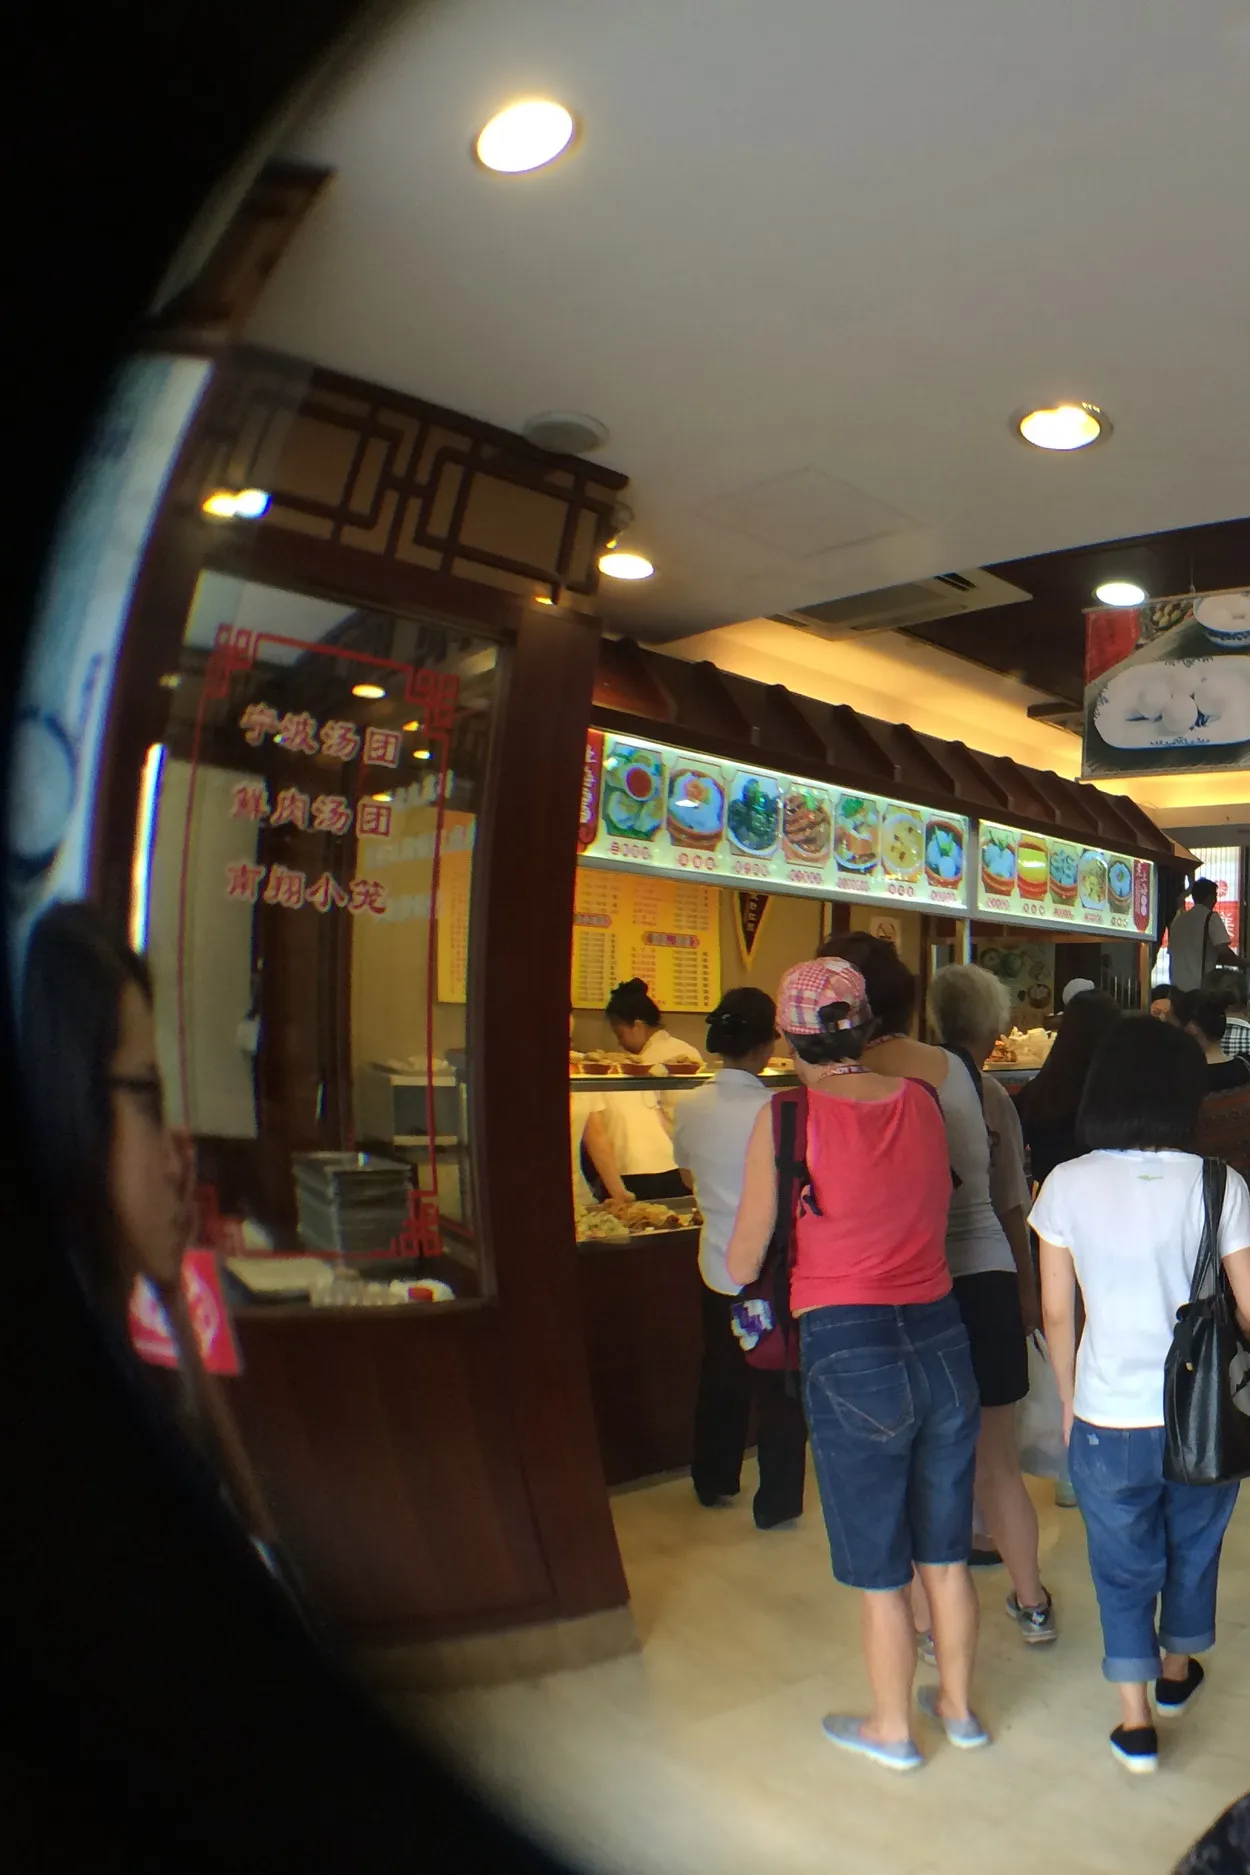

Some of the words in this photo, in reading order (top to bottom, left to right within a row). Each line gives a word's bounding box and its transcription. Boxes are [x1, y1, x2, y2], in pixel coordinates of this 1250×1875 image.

[240, 703, 401, 767] 宁波汤团
[231, 780, 392, 837] 鲜肉汤团
[226, 860, 387, 914] 南翔小笼
